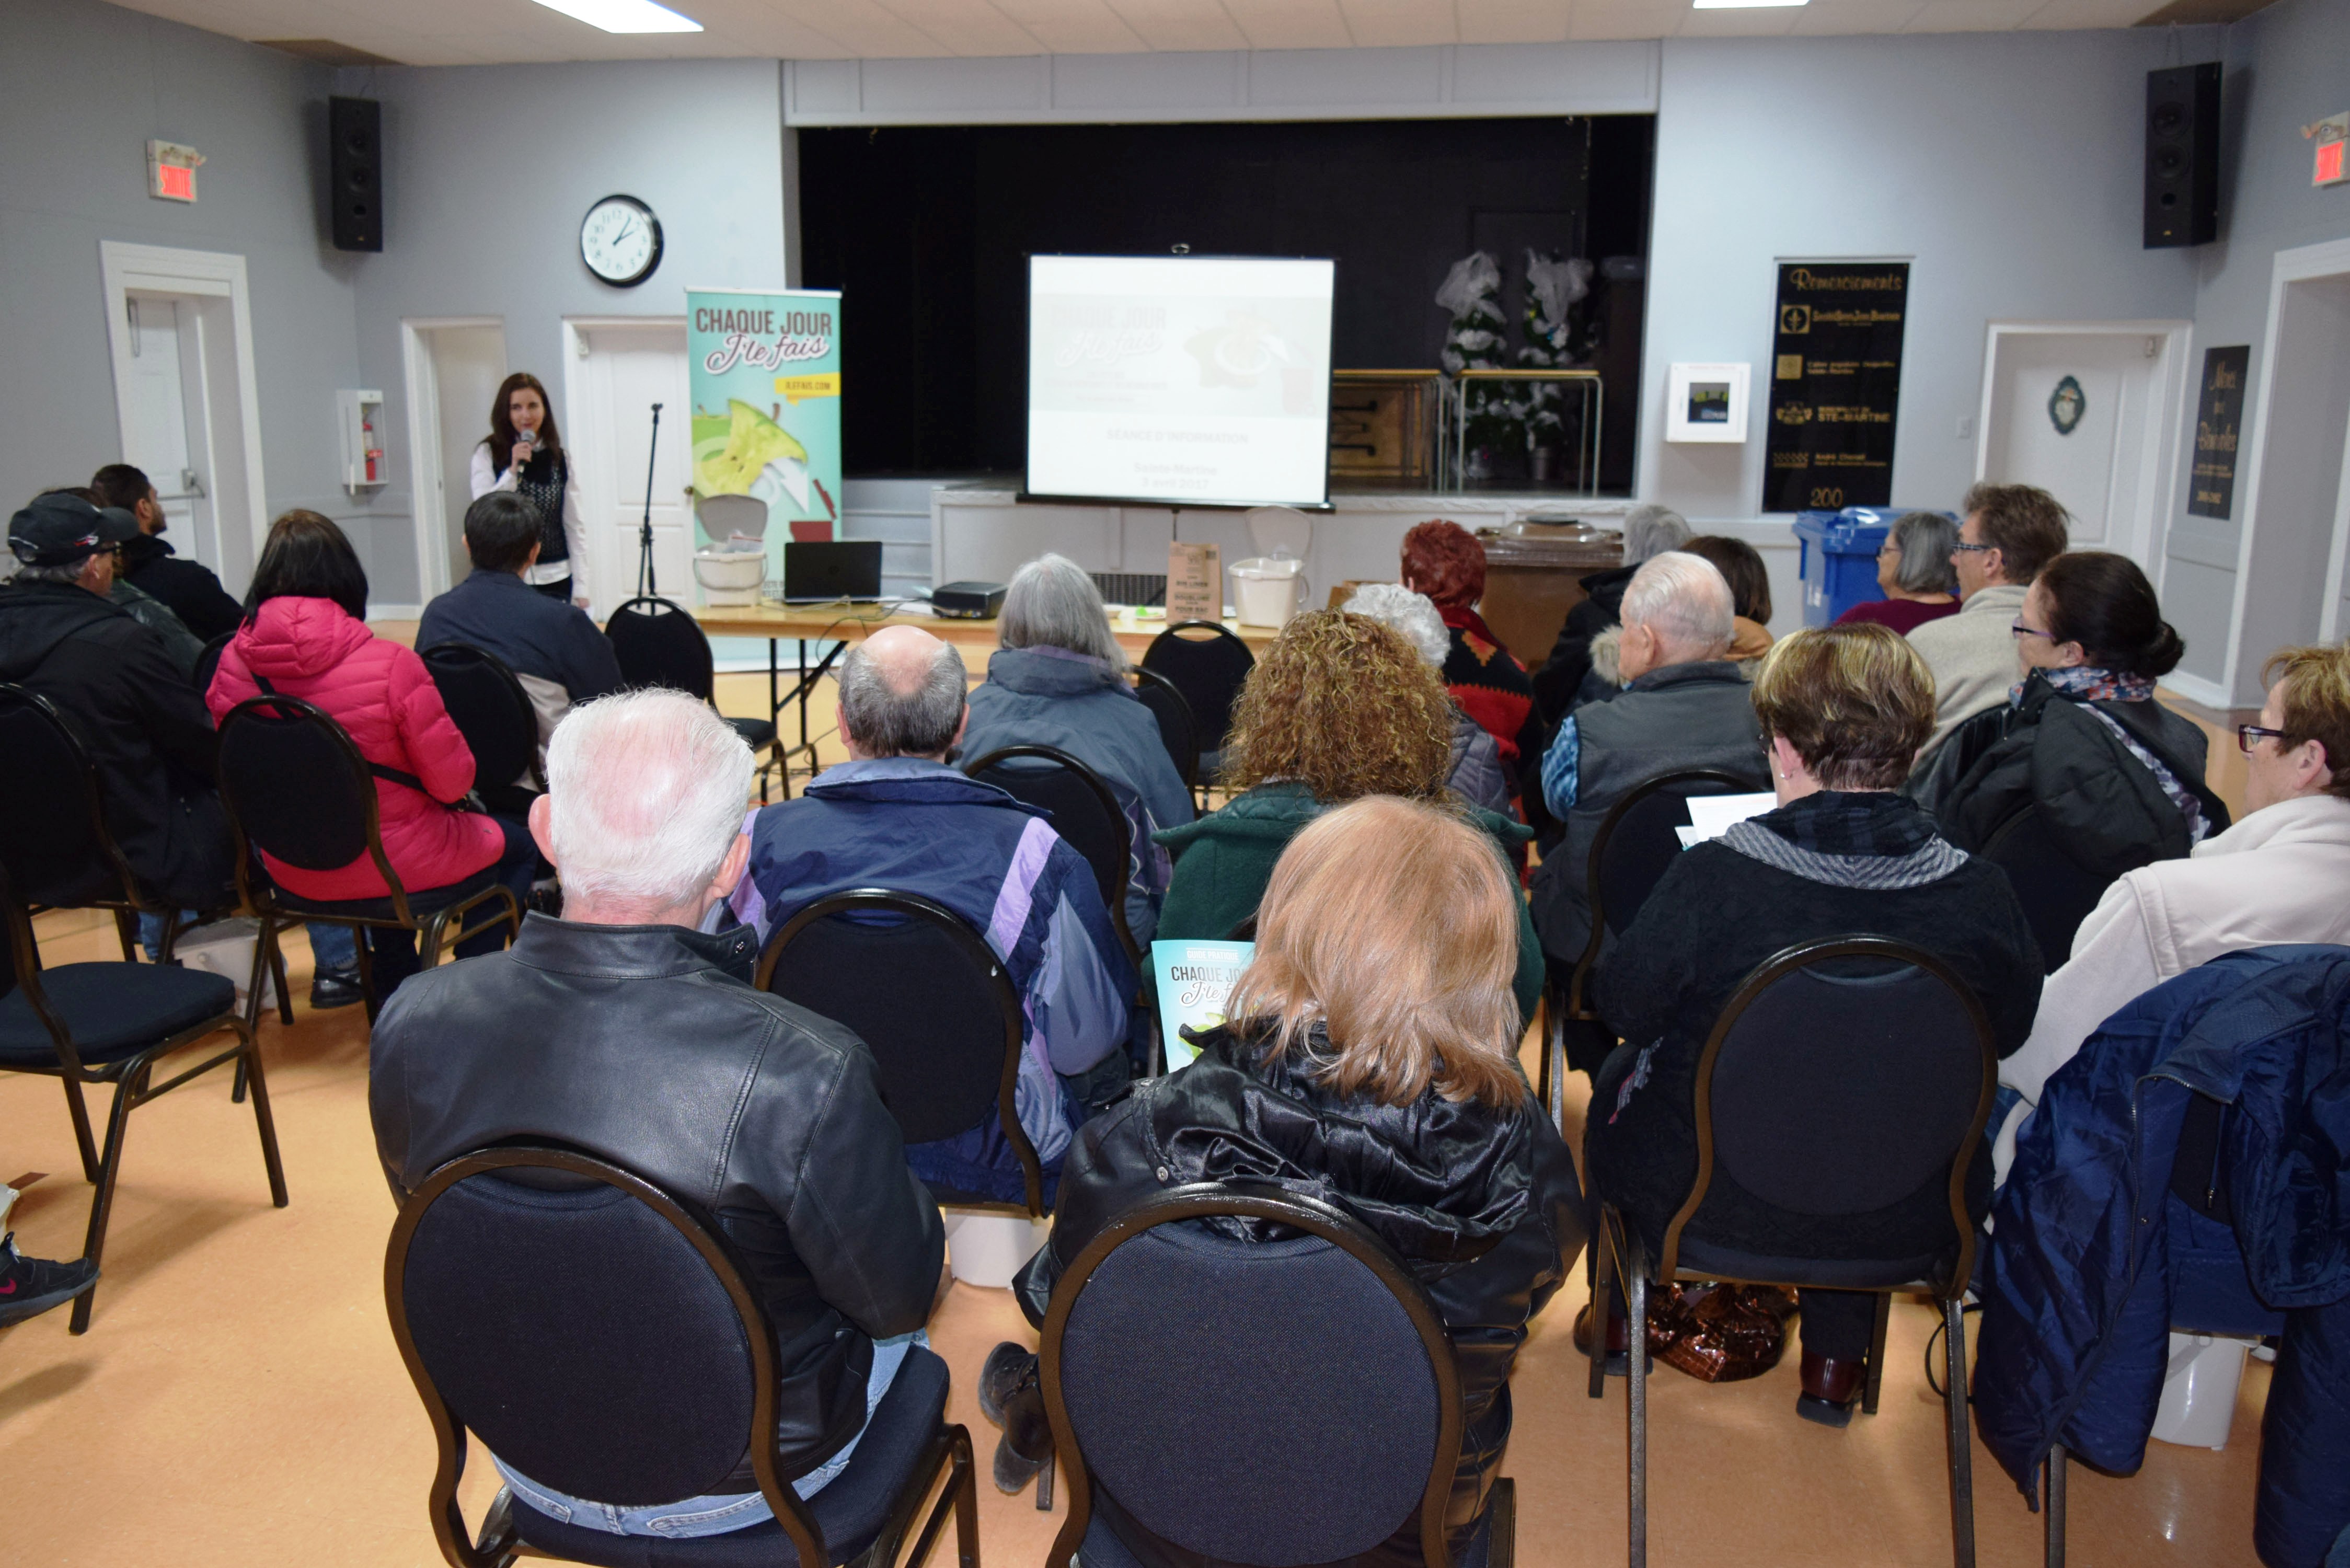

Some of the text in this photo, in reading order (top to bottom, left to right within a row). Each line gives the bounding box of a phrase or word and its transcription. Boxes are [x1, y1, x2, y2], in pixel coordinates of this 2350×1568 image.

[696, 308, 832, 336] CHAQUE JOUR
[765, 336, 827, 367] fais
[1107, 428, 1153, 441] SÉANCE
[1134, 462, 1218, 476] Sainte-Martine
[1142, 478, 1209, 490] 3 avril 2017
[1186, 950, 1239, 960] GUIDE PRATIQUE
[1171, 966, 1223, 982] CHAQUE
